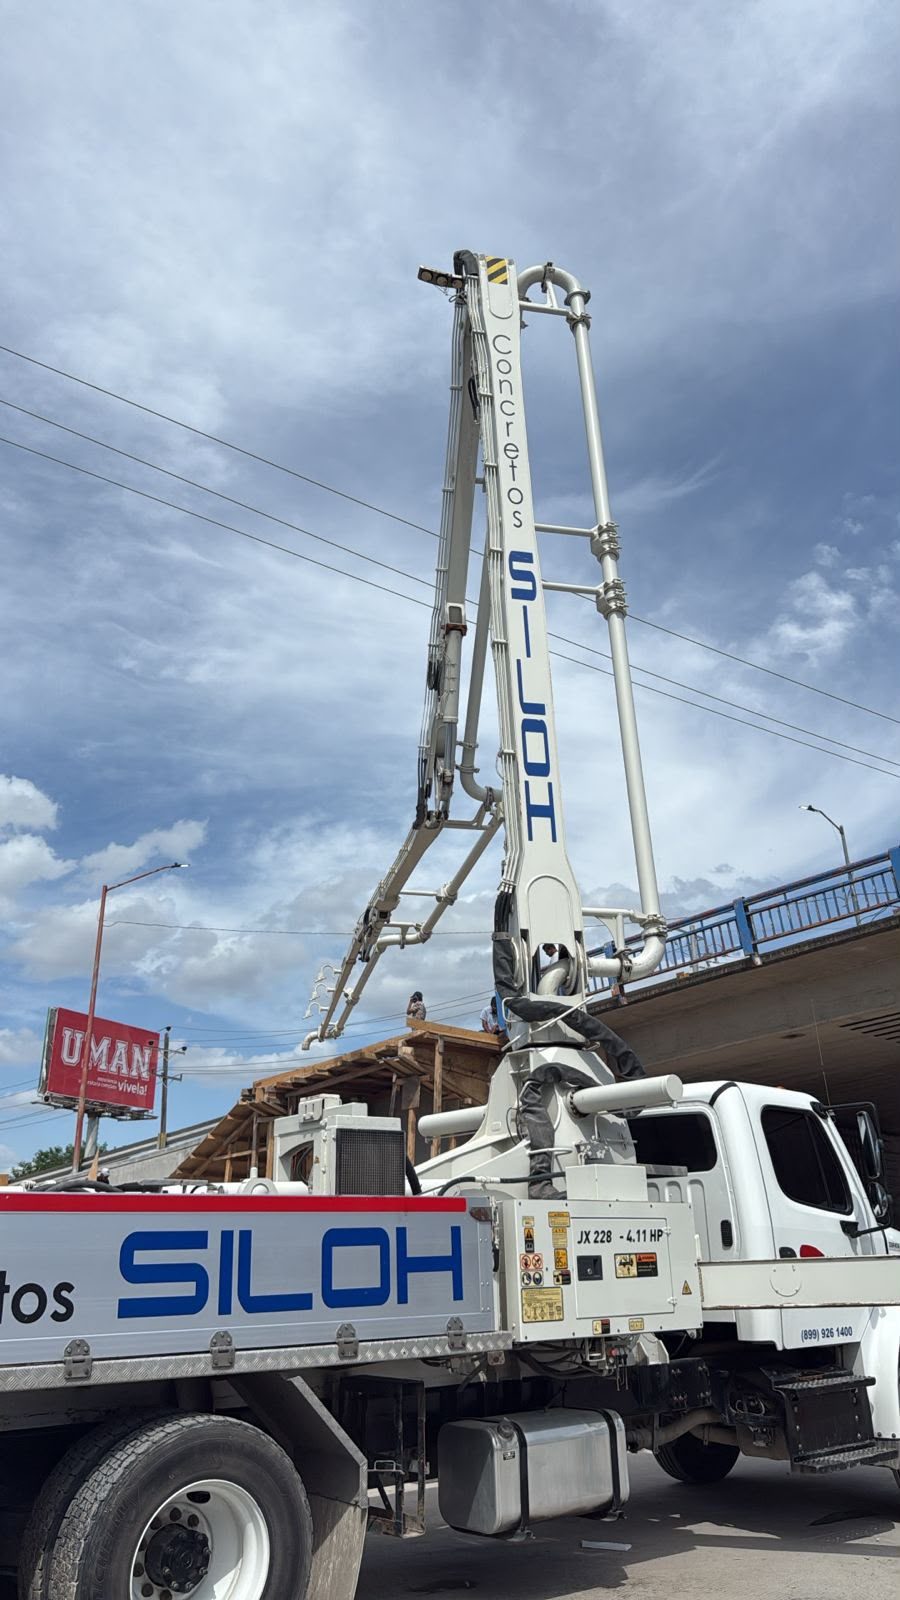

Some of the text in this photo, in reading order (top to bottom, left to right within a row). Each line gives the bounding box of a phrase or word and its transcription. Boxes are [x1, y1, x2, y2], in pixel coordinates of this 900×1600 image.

[492, 335, 557, 843] Concretos SILOH
[61, 1026, 152, 1081] UMAN
[577, 1230, 591, 1244] JX
[593, 1229, 612, 1244] 228
[626, 1229, 646, 1243] 4.11
[650, 1228, 664, 1242] HP
[117, 1225, 464, 1319] SILOH
[801, 1326, 853, 1343] (899) 926 1400
